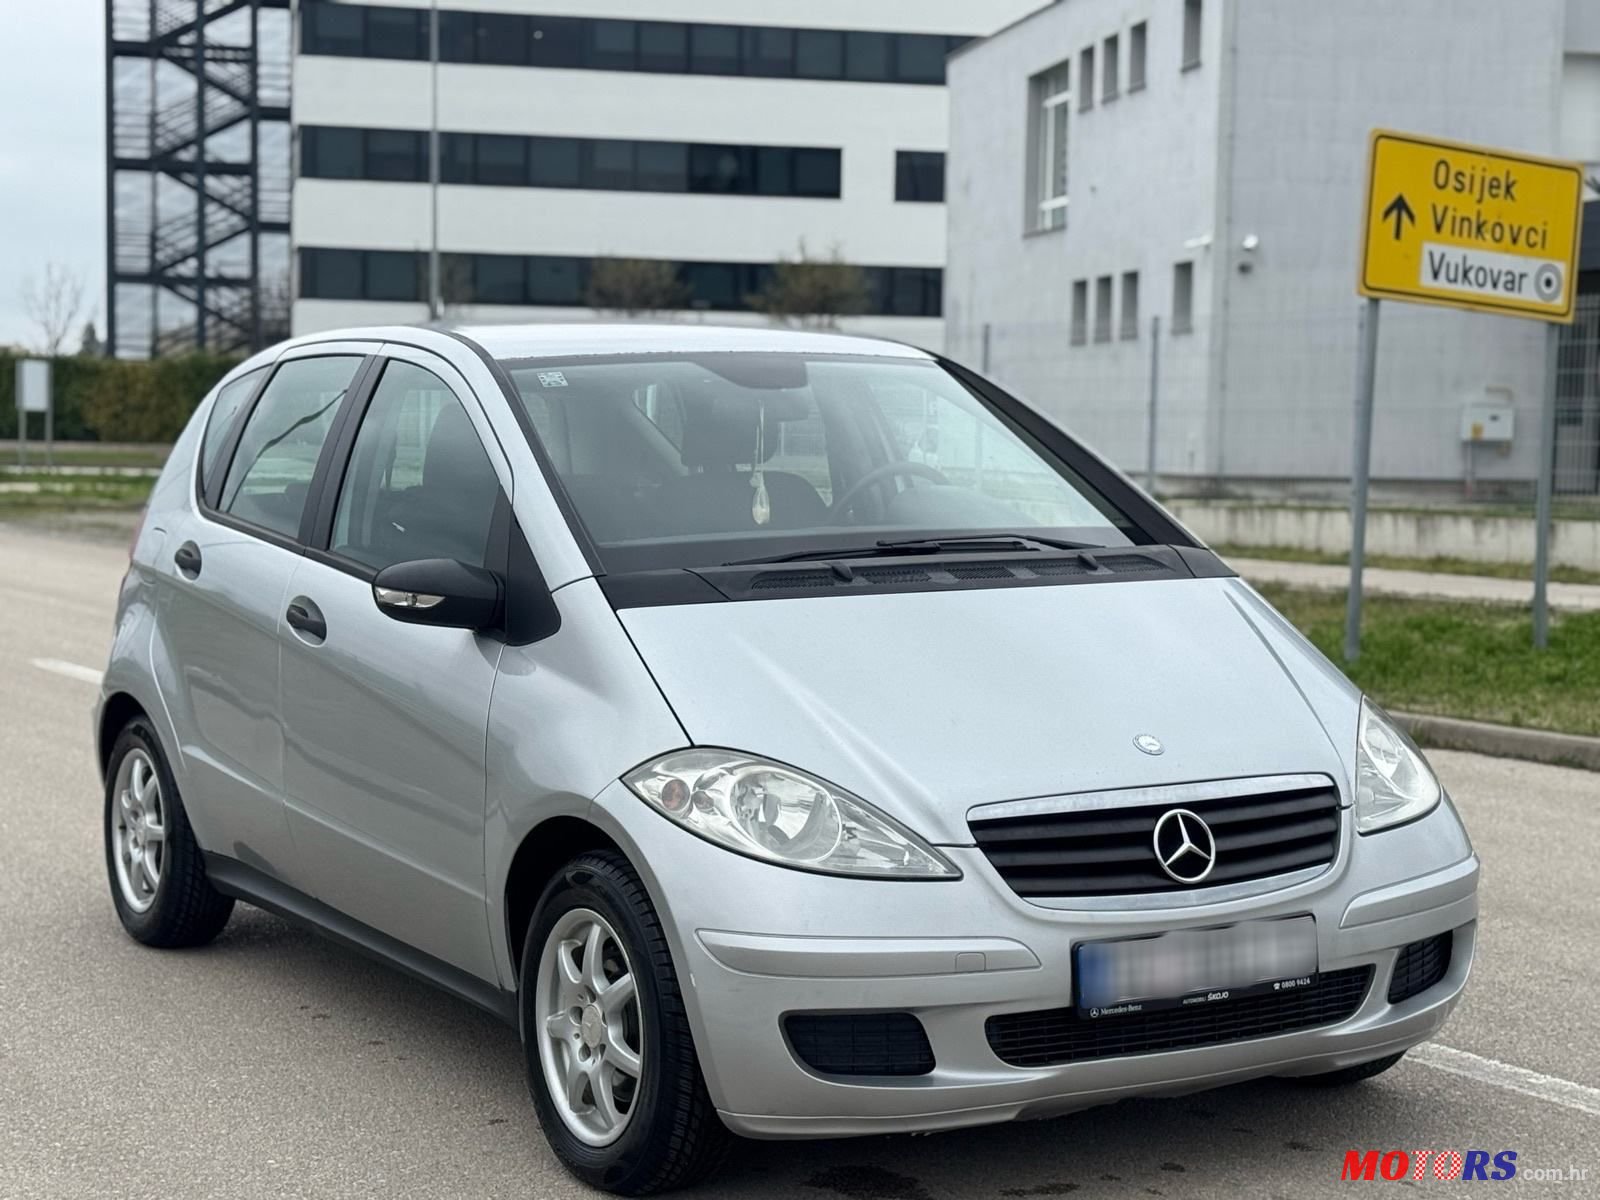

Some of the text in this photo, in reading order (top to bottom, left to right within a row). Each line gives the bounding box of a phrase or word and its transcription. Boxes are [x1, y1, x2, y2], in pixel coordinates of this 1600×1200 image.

[1433, 159, 1518, 204] Osijek
[1432, 202, 1548, 250] Vinkovci
[1429, 250, 1527, 294] Vukovar
